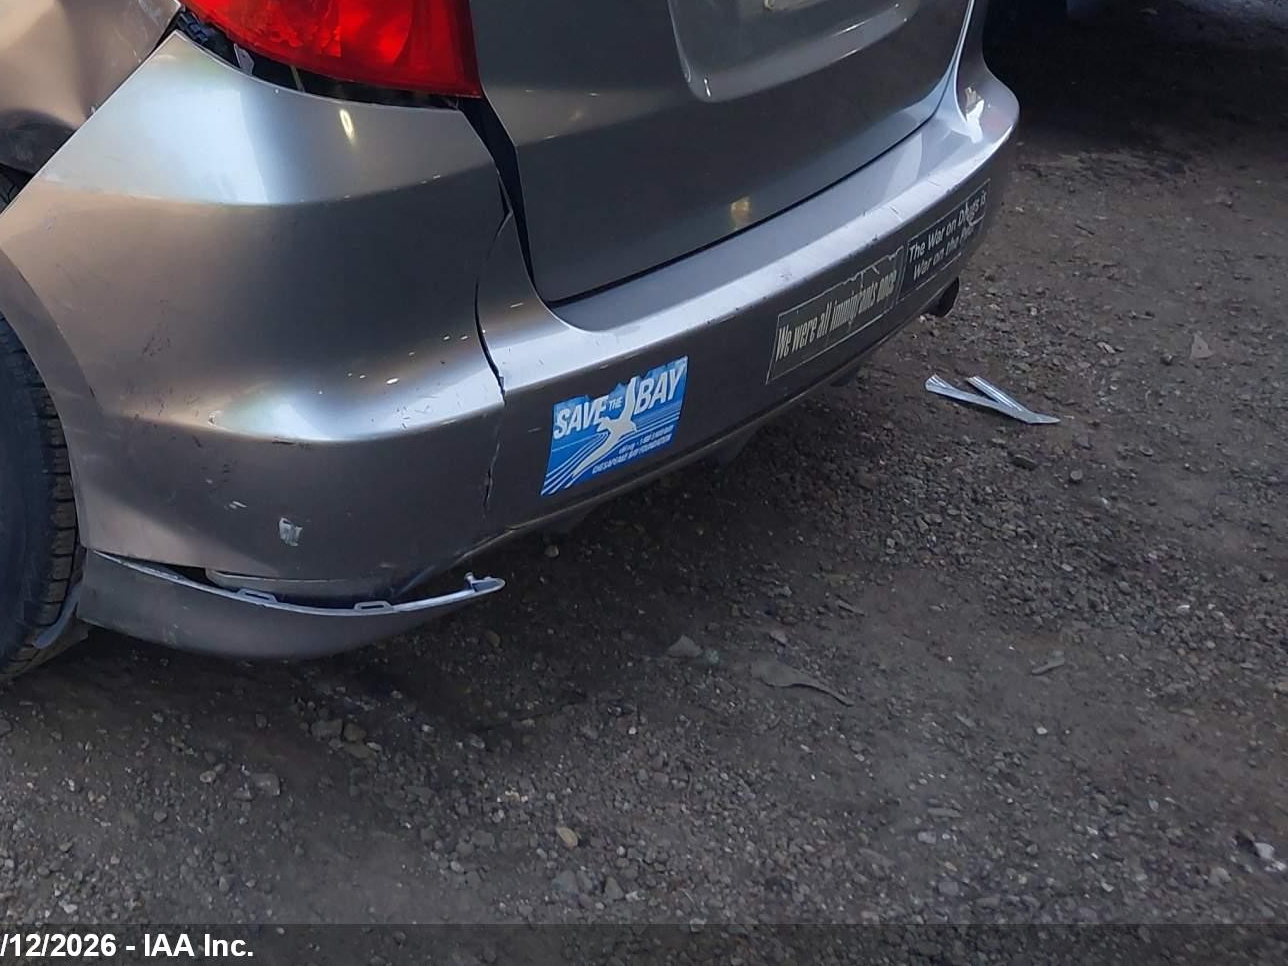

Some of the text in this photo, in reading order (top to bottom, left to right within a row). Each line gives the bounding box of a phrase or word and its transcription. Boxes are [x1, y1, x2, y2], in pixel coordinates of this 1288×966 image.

[909, 241, 926, 263] The
[928, 228, 945, 251] War
[946, 219, 957, 235] on
[913, 257, 932, 281] War
[775, 270, 897, 362] We were all immigrants once
[553, 365, 686, 439] SAVE THE BAY
